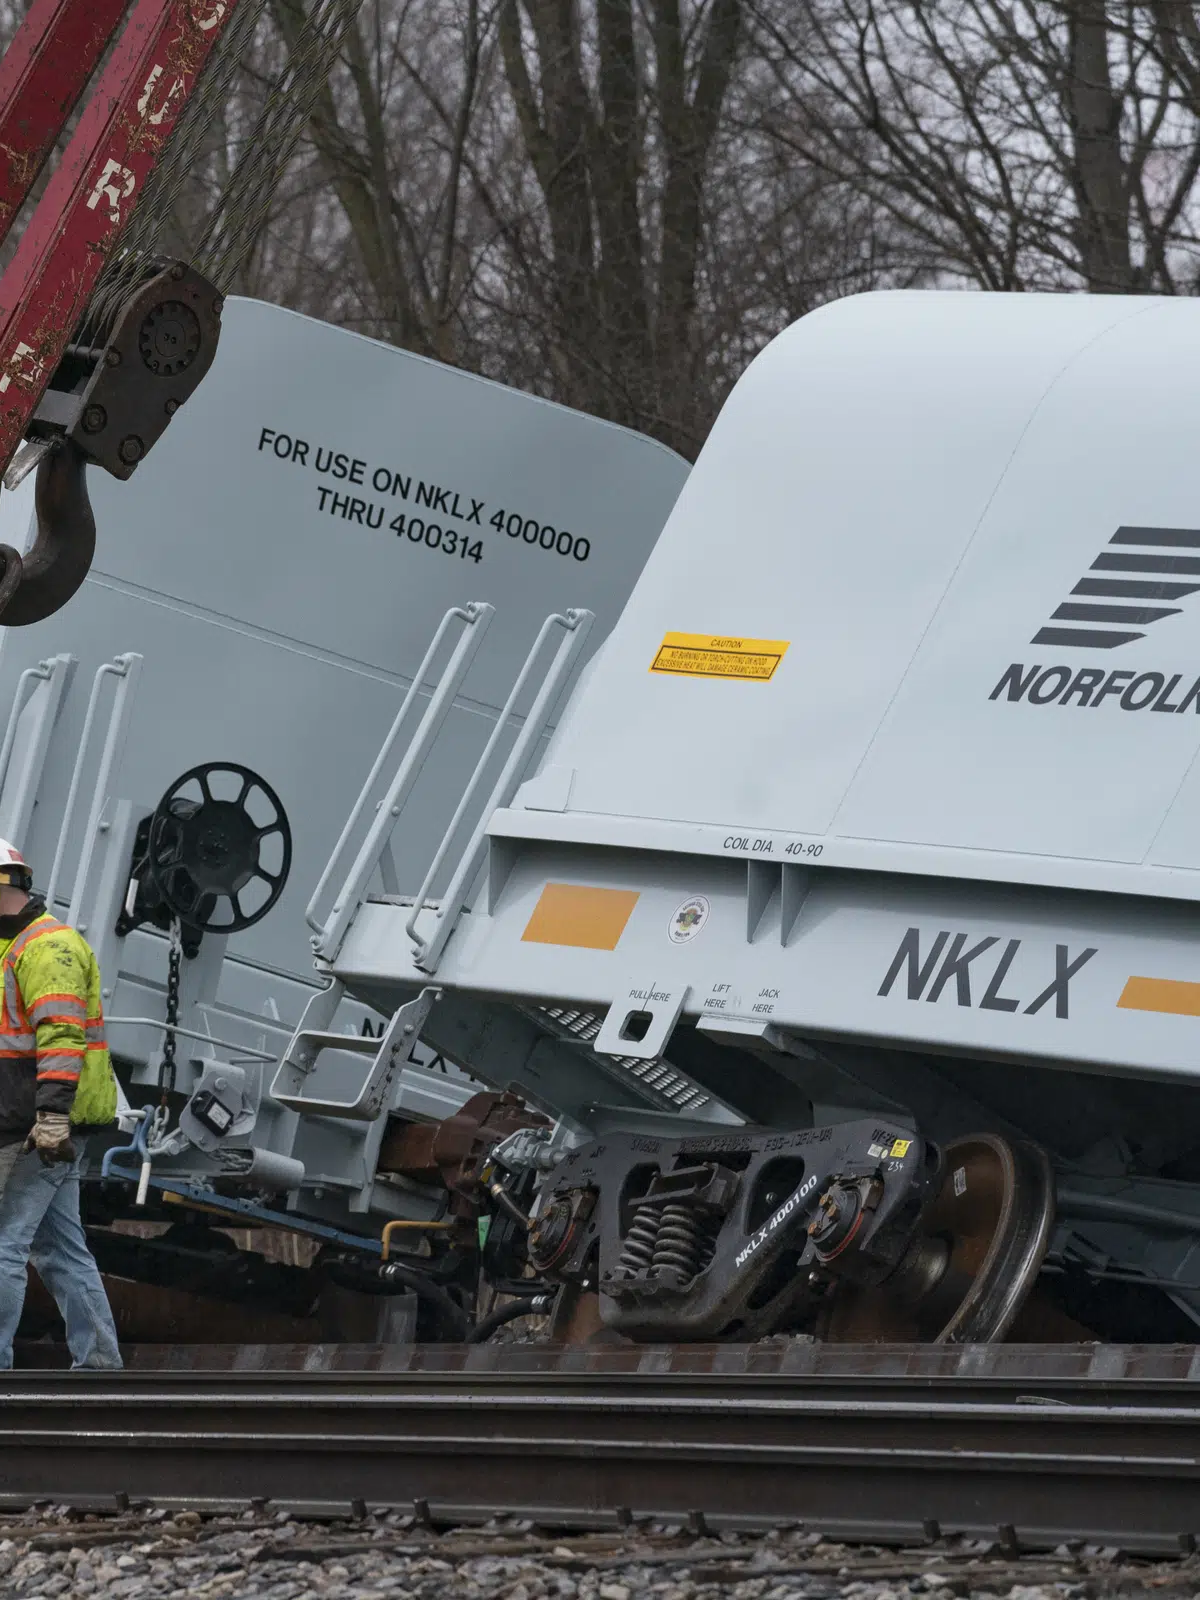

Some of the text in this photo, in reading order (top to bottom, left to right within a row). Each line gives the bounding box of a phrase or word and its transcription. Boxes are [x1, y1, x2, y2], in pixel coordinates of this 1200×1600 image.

[258, 428, 591, 562] FOR USE ON NKLX 400000
[317, 486, 484, 564] THRU 400314
[711, 639, 743, 649] CAUTION
[723, 836, 824, 857] COIL DIA. 40-90
[877, 928, 1099, 1020] NKLX
[712, 983, 731, 994] LIFT
[758, 988, 780, 999] JACK
[629, 989, 671, 1002] PULL HERE
[704, 998, 726, 1009] HERE
[752, 1003, 774, 1014] HERE
[734, 1175, 818, 1268] NKLX 400100
